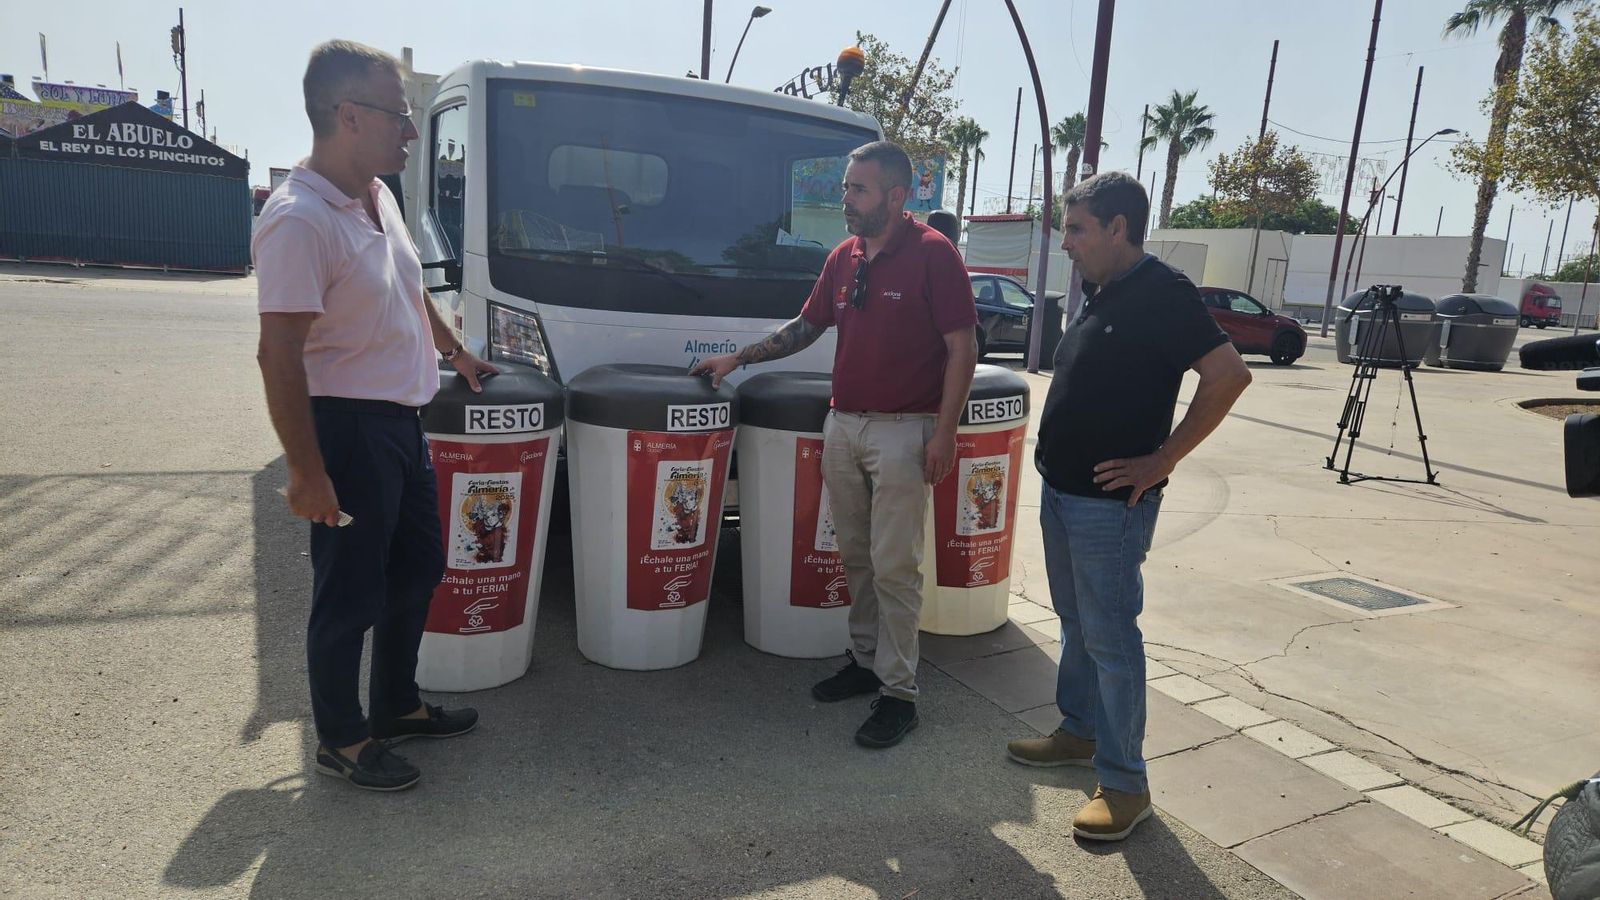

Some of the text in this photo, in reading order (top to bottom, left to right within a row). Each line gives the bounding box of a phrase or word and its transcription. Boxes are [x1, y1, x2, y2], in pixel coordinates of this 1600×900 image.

[41, 84, 70, 101] SOL
[72, 123, 193, 149] EL ABUELO
[39, 141, 225, 167] EL REY DE LOS PINCHITOS
[671, 406, 728, 427] RESTO
[972, 399, 1021, 420] RESTO
[469, 407, 541, 430] RESTO
[977, 546, 1001, 554] FERIA!
[640, 553, 674, 564] ¡Échale
[804, 554, 835, 564] ¡Échale
[674, 561, 699, 572] FERIA!
[441, 571, 521, 585] Échale una mano
[476, 584, 509, 594] FERIA!
